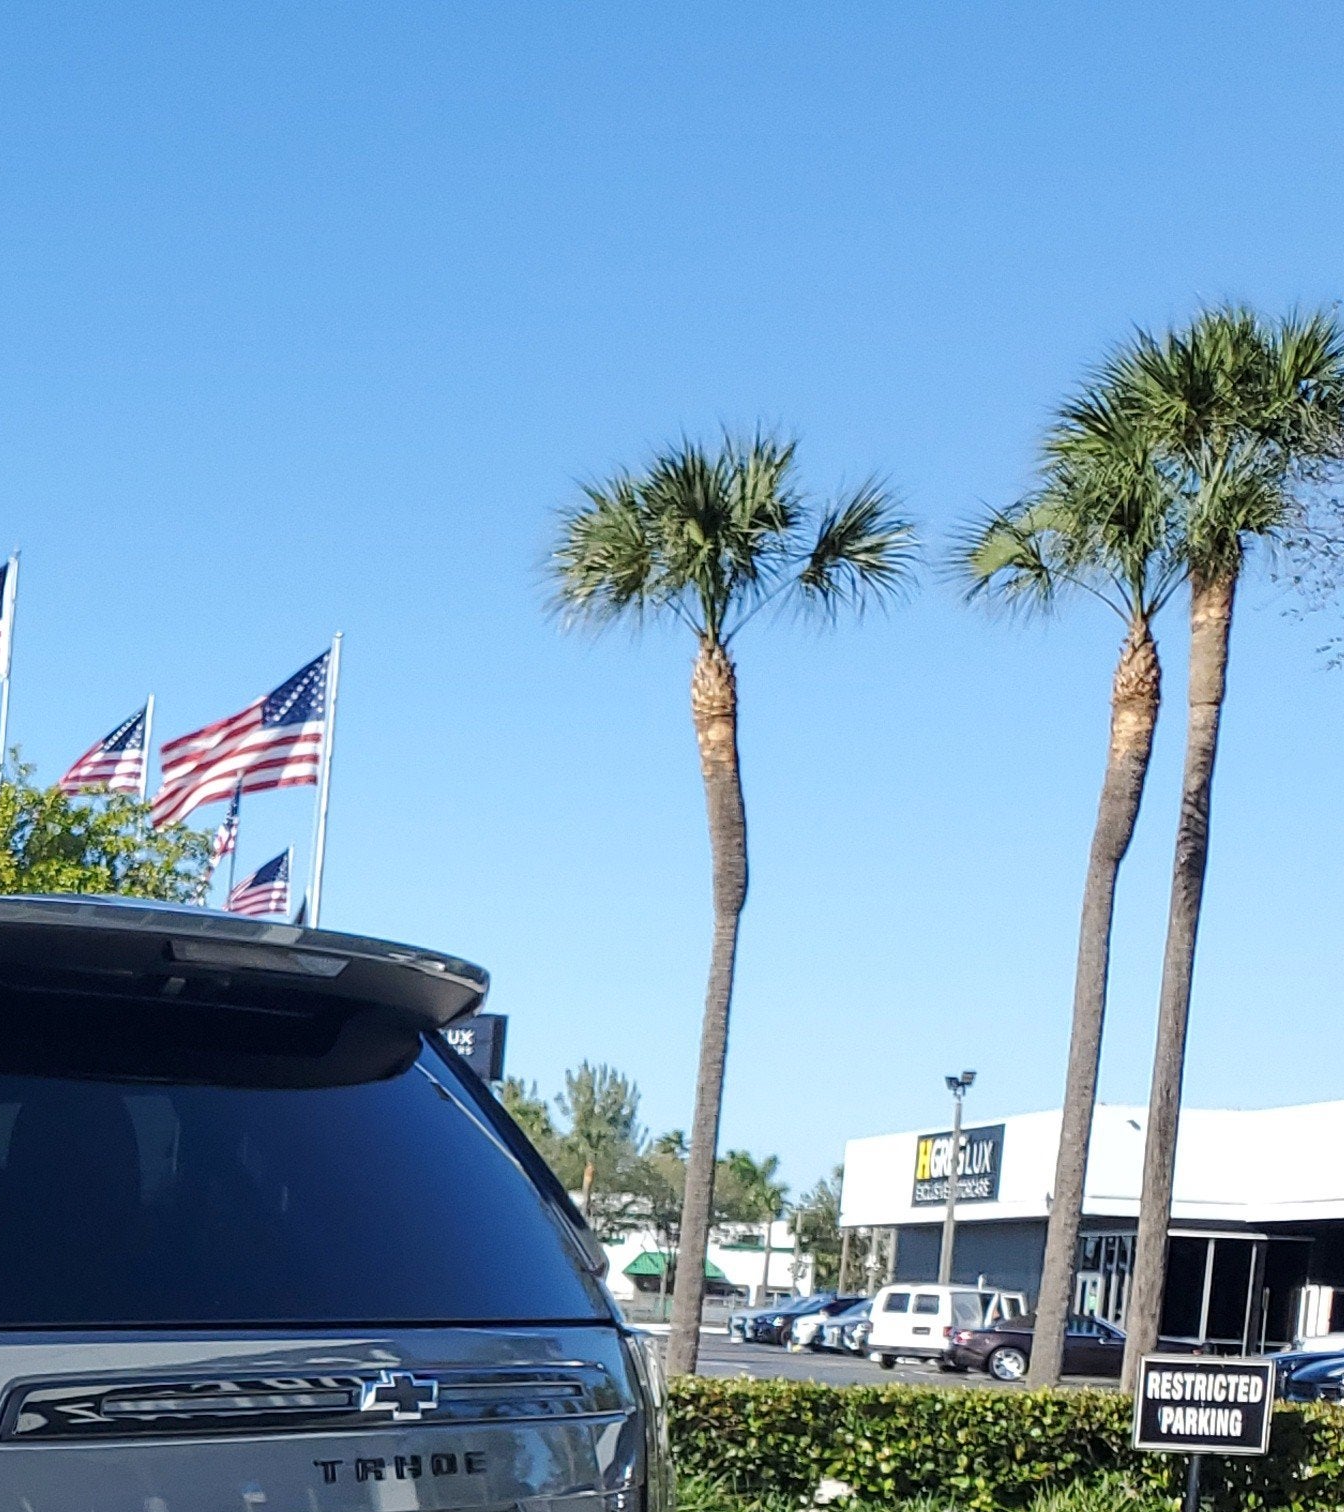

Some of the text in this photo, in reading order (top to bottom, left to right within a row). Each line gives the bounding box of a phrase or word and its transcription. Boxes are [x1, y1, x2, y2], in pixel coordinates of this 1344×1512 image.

[446, 1028, 475, 1046] UX
[1147, 1370, 1263, 1403] RESTRICTED
[1159, 1405, 1243, 1437] PARKING
[314, 1451, 487, 1484] TAHOE
